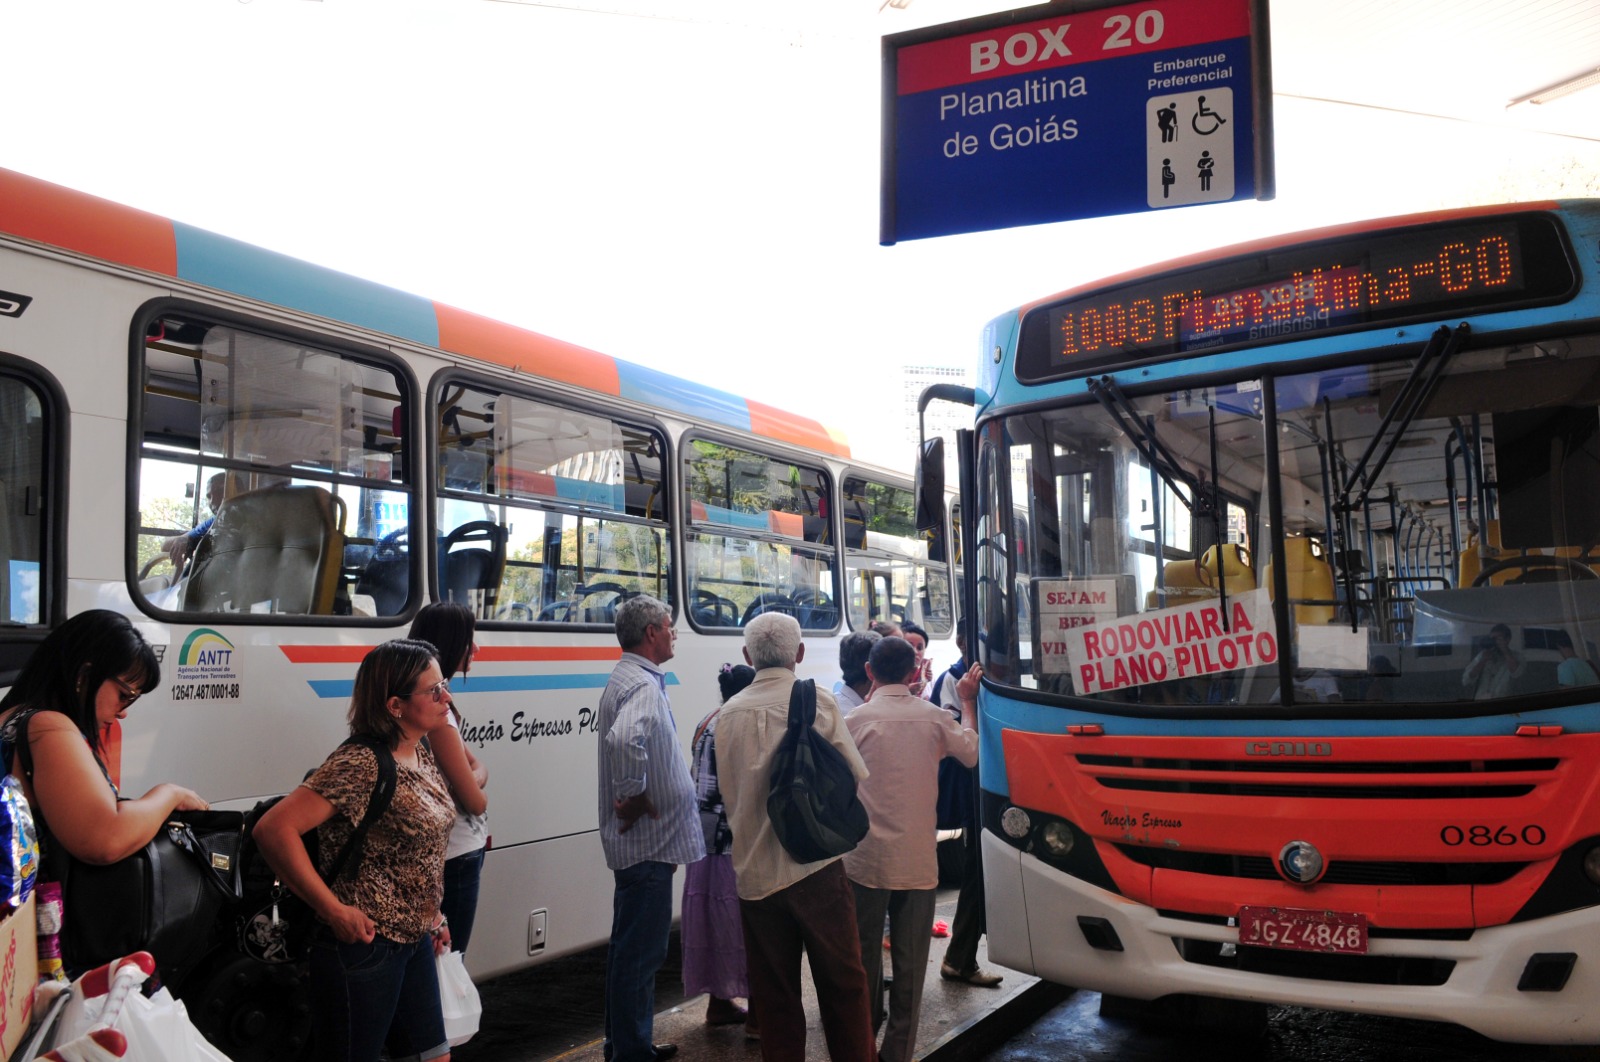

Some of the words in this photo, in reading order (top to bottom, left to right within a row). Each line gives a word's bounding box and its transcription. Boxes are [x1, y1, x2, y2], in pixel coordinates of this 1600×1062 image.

[969, 23, 1073, 75] BOX
[1101, 9, 1165, 51] 20
[1153, 52, 1227, 73] Embarque
[1147, 66, 1234, 91] Preferencial
[940, 76, 1088, 121] Planaltina
[943, 131, 979, 158] de
[989, 115, 1079, 150] Goiás
[1046, 591, 1107, 606] SEJAM
[197, 650, 232, 665] ANTT
[1080, 651, 1167, 693] PLANO
[1173, 631, 1277, 677] PILOTO
[510, 711, 573, 745] Expresso
[1246, 742, 1332, 756] CAIO
[1142, 812, 1182, 829] Expresso
[1440, 825, 1546, 847] 0860
